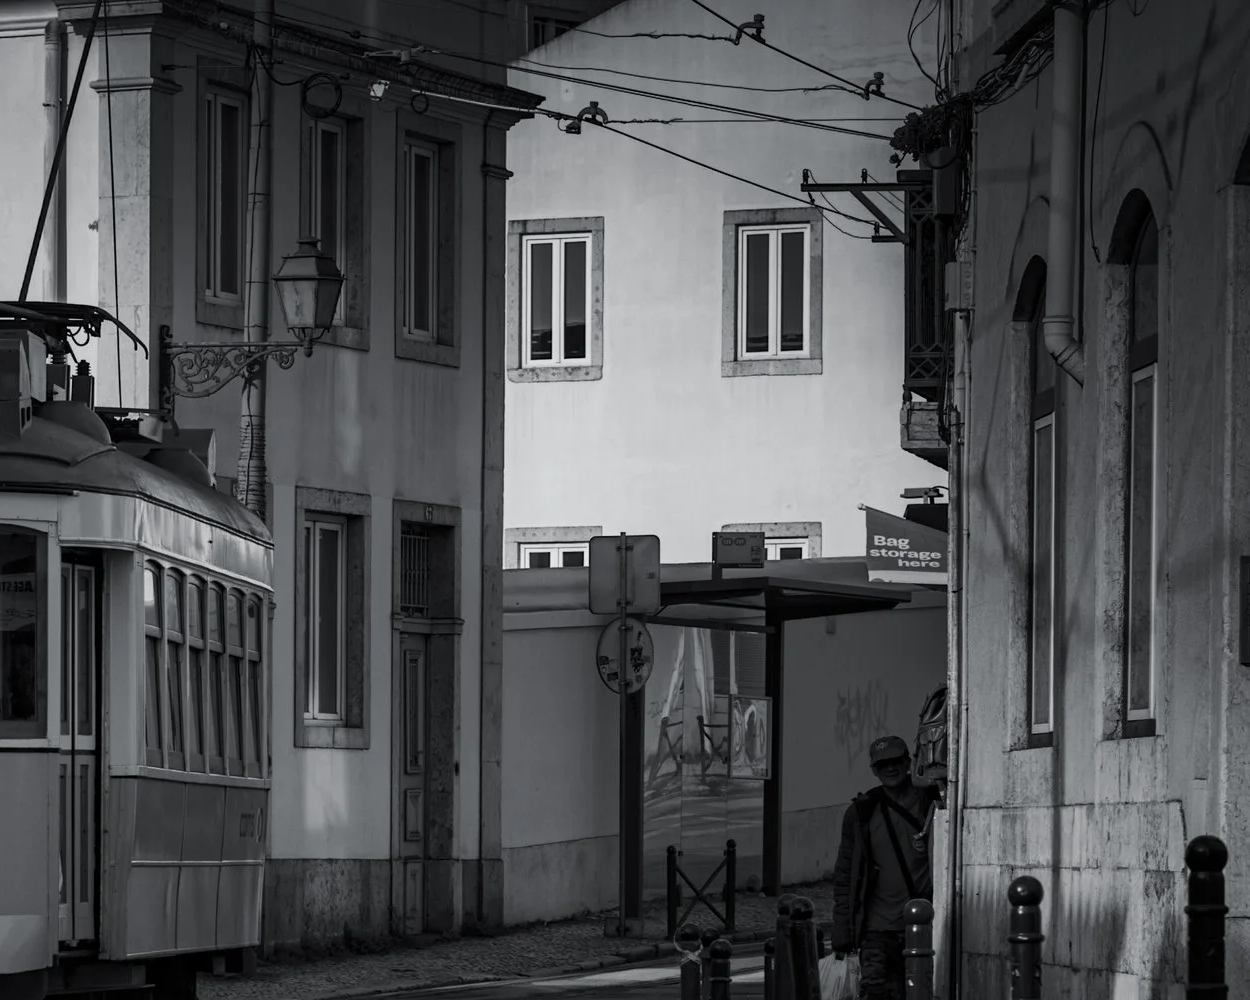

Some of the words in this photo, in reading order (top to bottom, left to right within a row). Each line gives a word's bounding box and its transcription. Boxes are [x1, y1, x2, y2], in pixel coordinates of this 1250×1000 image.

[873, 535, 910, 550] Bag
[869, 547, 942, 561] storage
[897, 558, 941, 568] here
